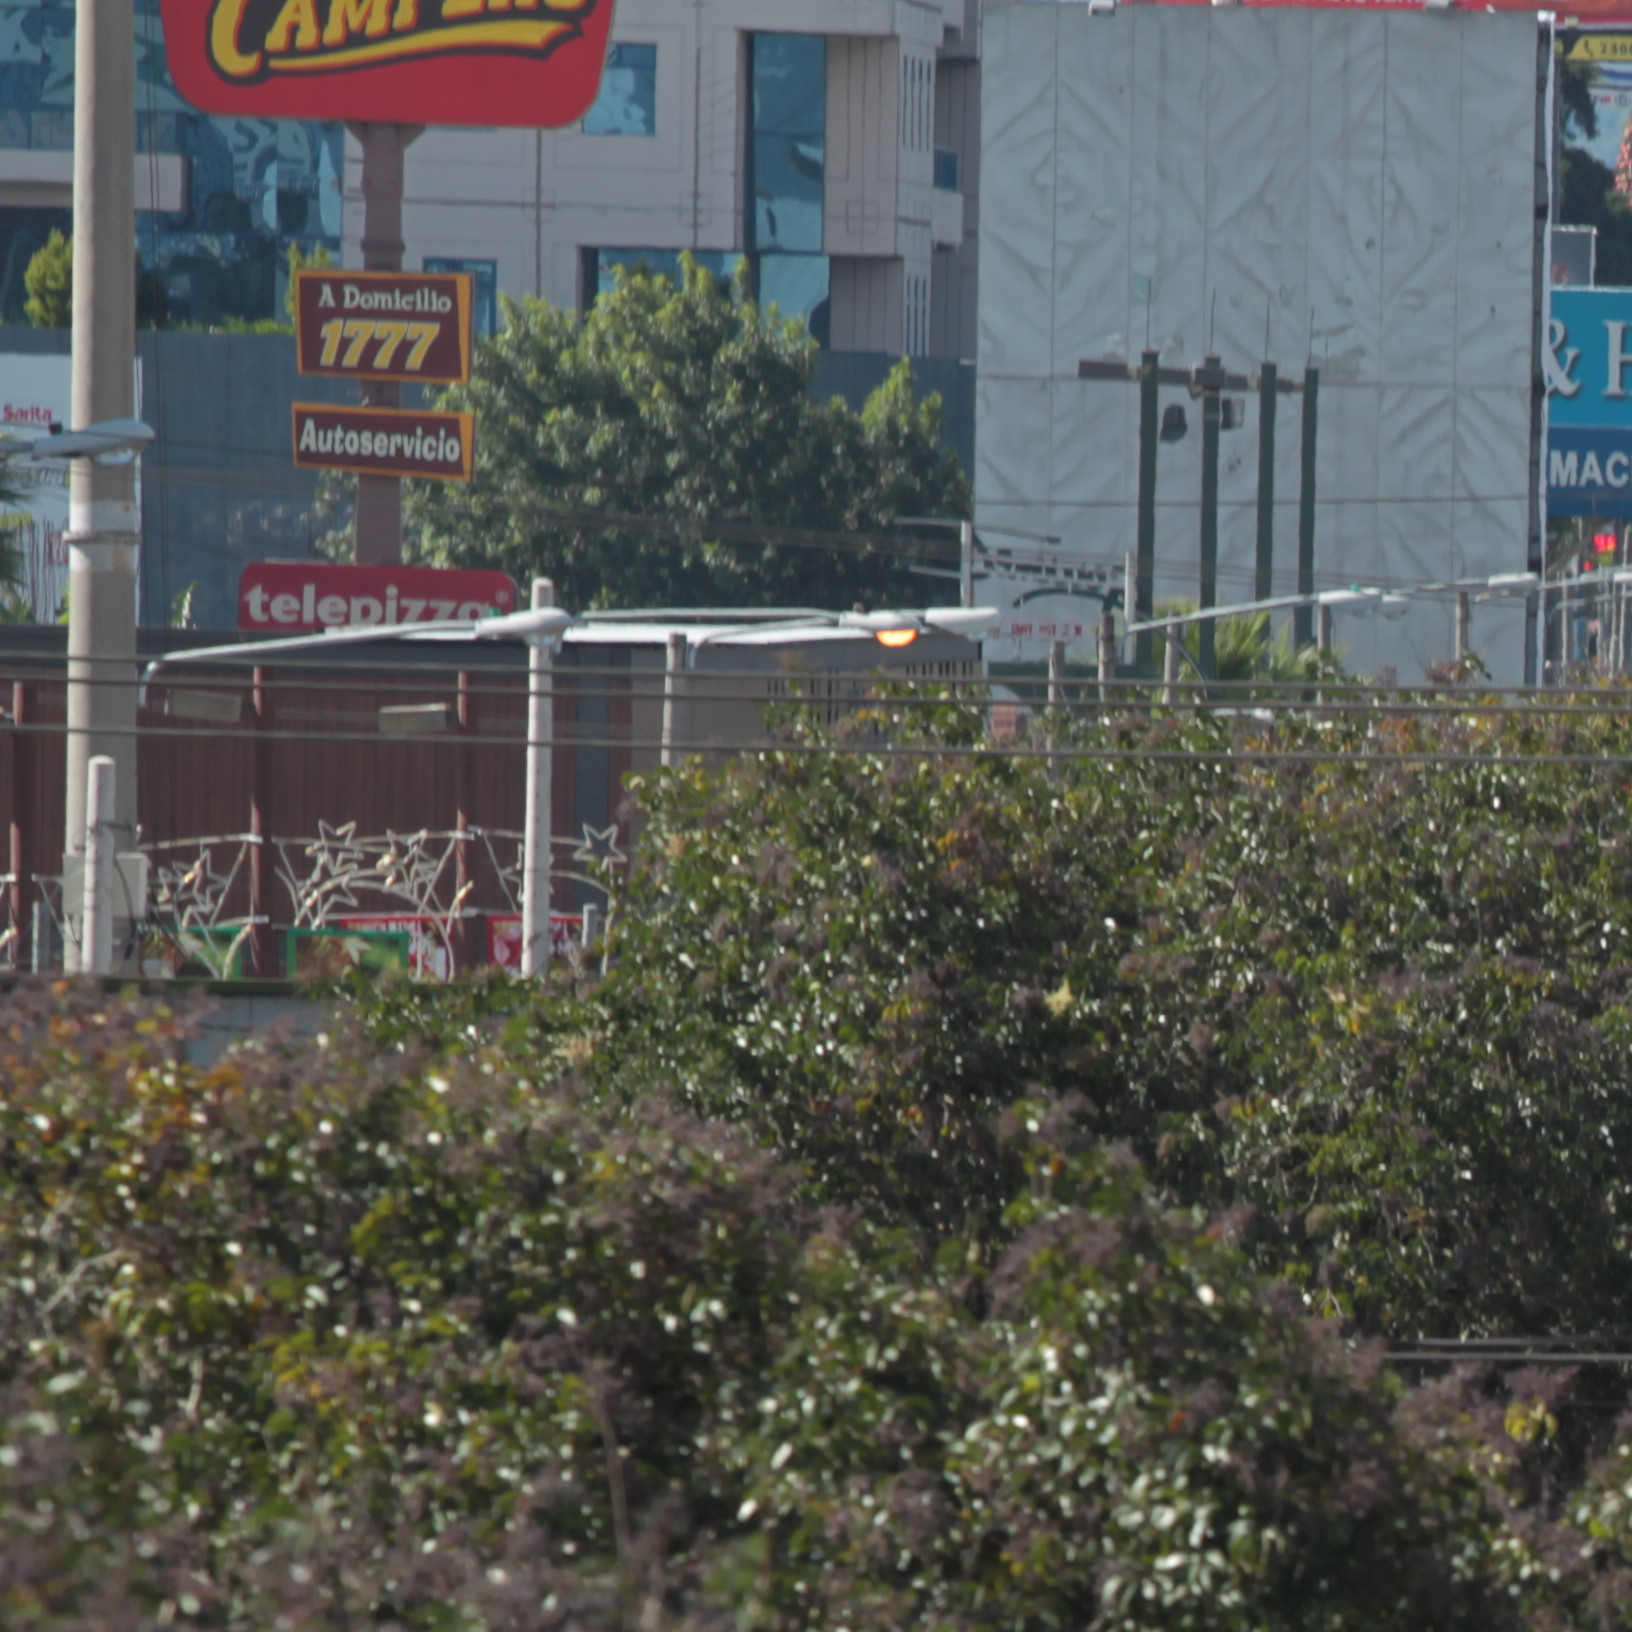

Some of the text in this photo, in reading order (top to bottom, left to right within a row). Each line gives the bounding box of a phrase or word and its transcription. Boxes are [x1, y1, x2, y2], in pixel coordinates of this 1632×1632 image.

[317, 285, 452, 314] A Domicilio
[319, 318, 441, 371] 1777
[299, 418, 461, 463] Autoservicio
